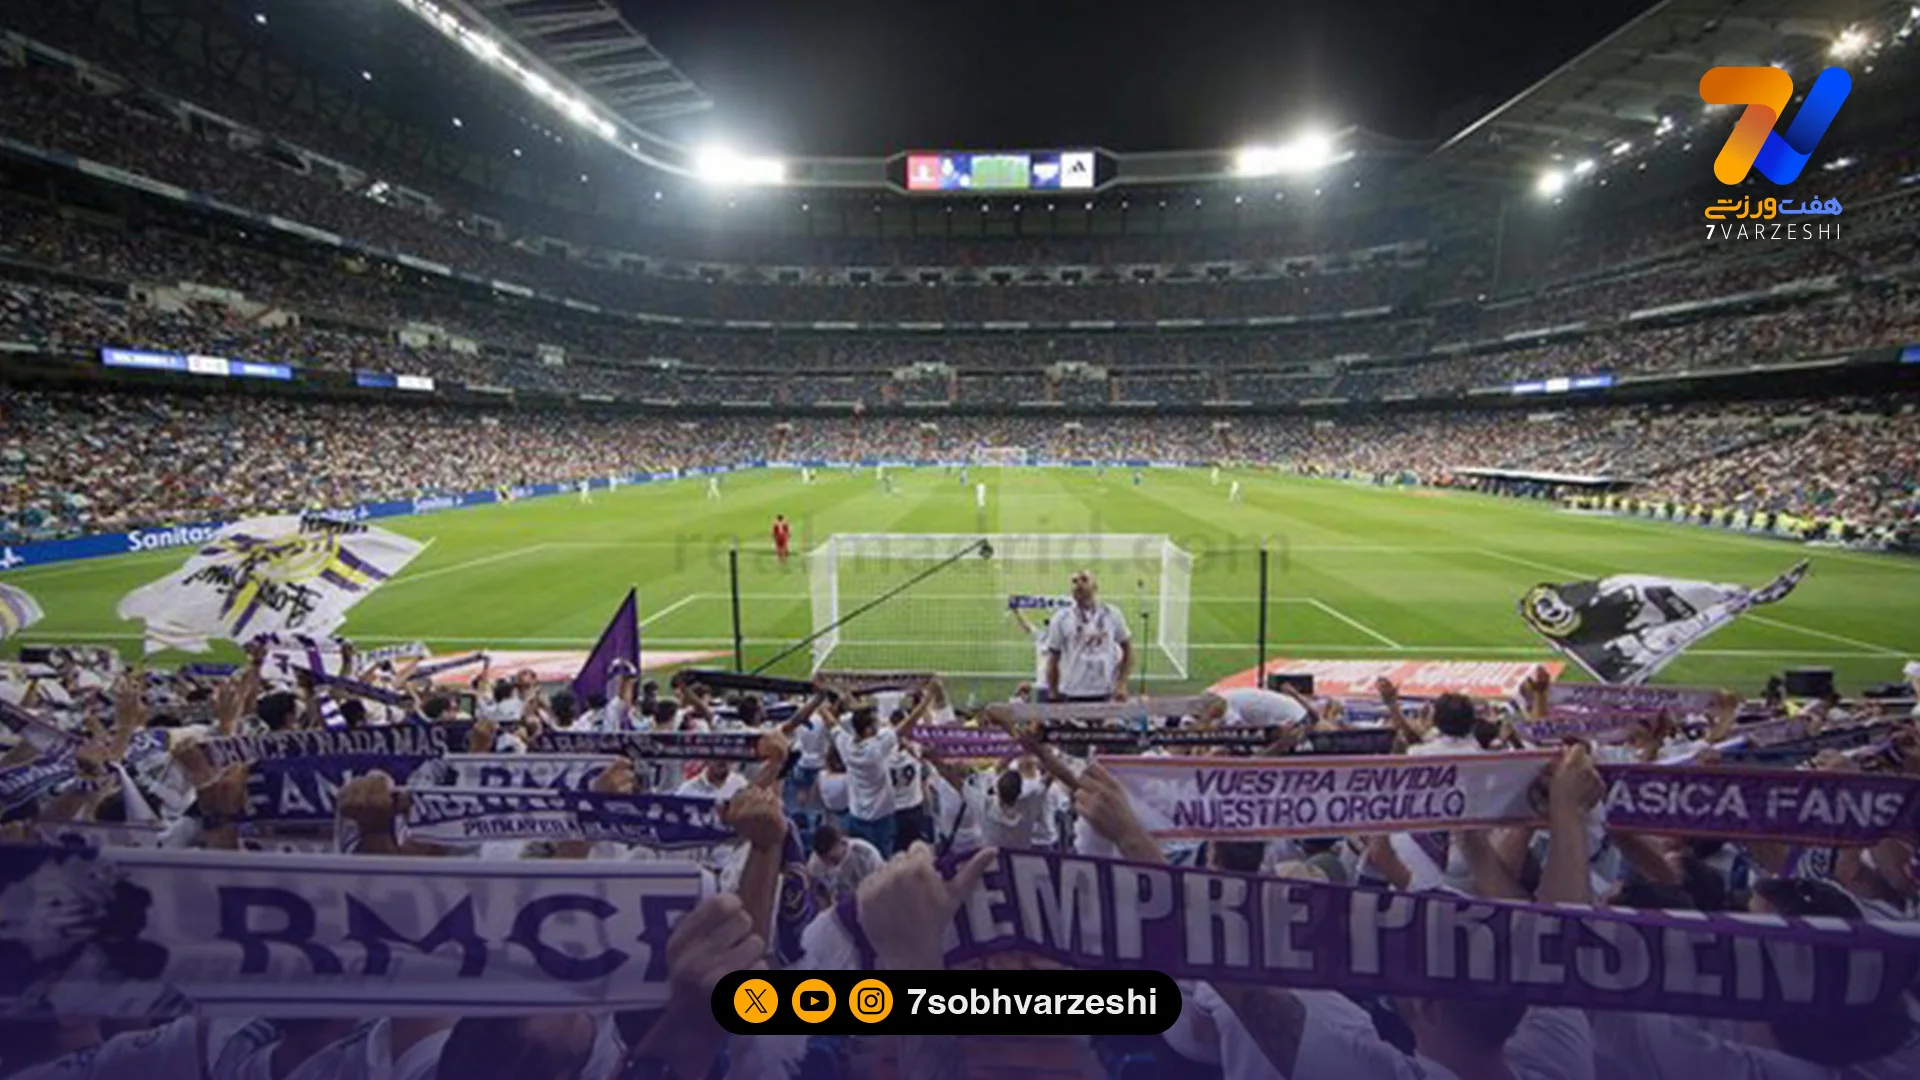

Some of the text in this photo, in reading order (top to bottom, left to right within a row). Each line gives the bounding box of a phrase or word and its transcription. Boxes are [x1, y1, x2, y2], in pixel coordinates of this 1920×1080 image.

[127, 526, 213, 551] Sanitas
[1194, 764, 1458, 796] VUESTRA ENVIDIA
[1173, 790, 1465, 828] NUESTRO ORGULLO
[1605, 778, 1905, 828] ASICA FANS
[942, 852, 1316, 972] EMPRE
